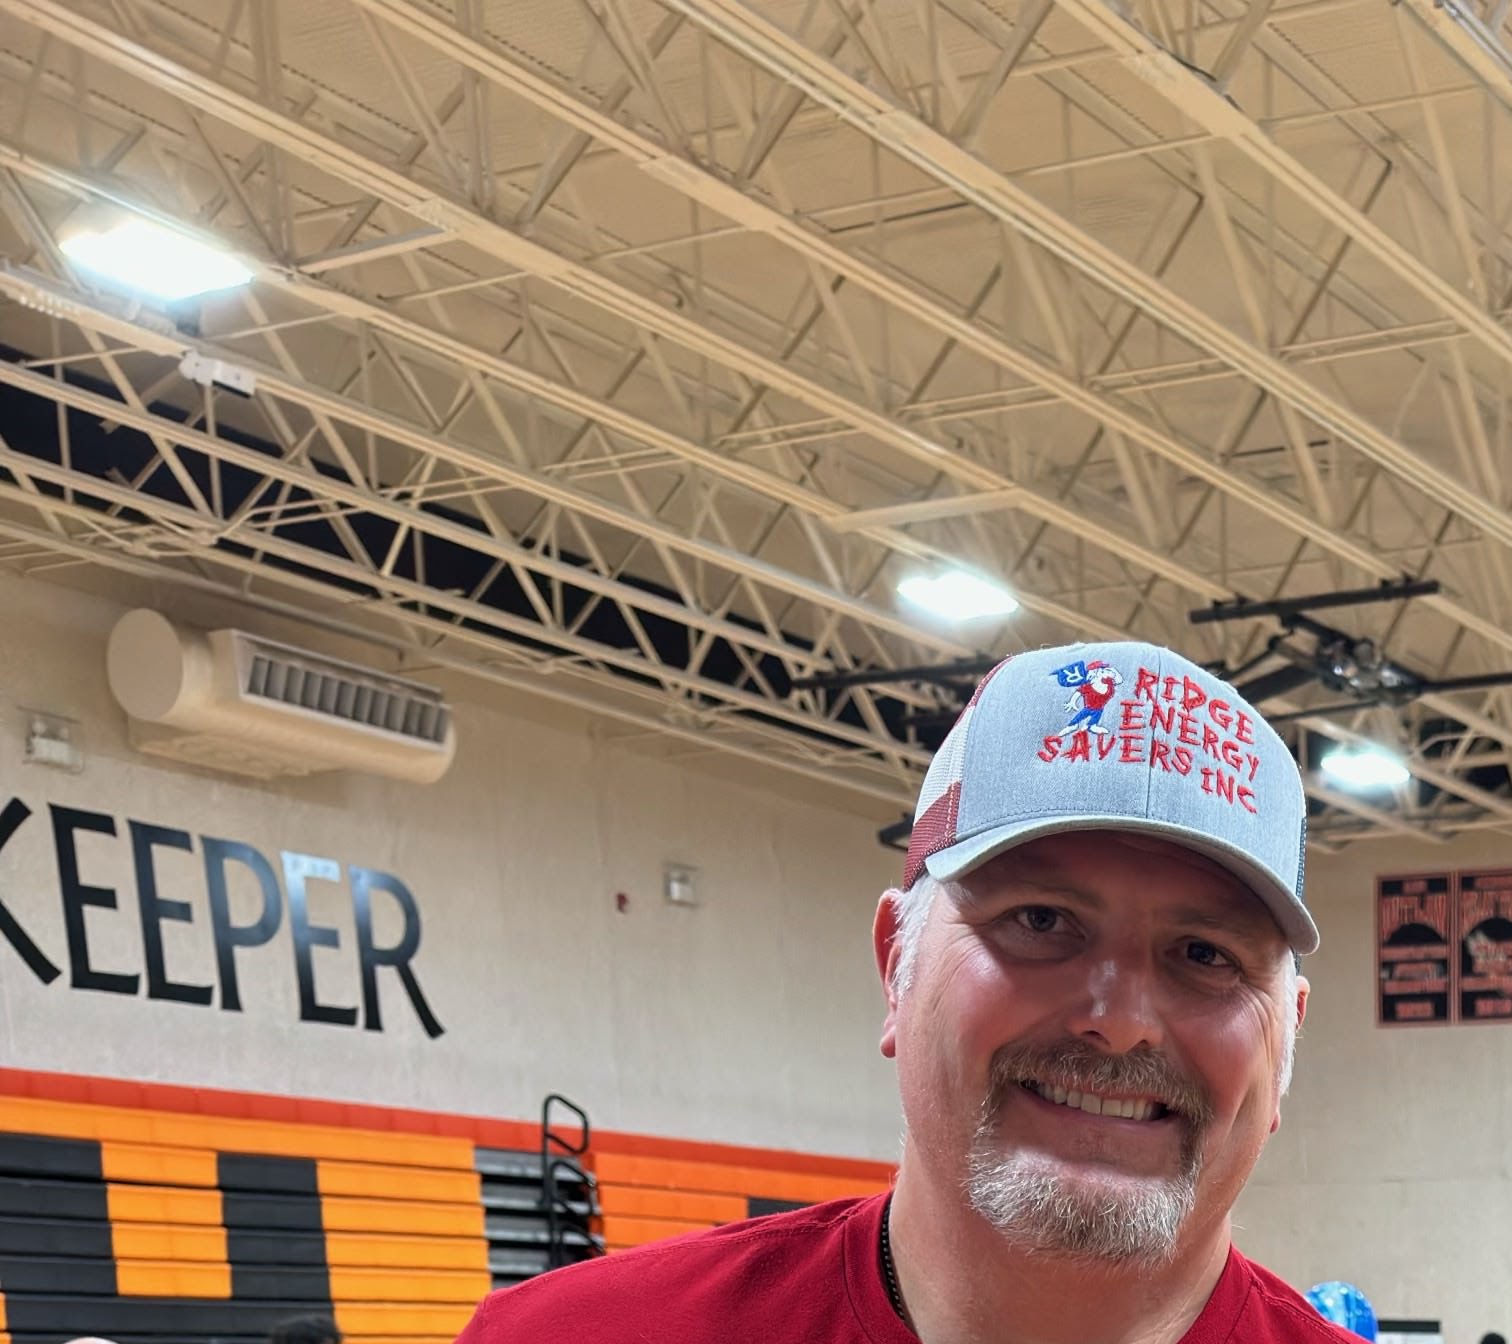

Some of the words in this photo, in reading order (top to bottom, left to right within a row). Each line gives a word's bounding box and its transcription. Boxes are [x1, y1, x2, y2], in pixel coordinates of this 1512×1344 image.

[1118, 699, 1260, 783] ENERGY
[1134, 667, 1255, 746] RIDGE
[1037, 731, 1194, 776] SAVERS
[1200, 766, 1258, 815] INC
